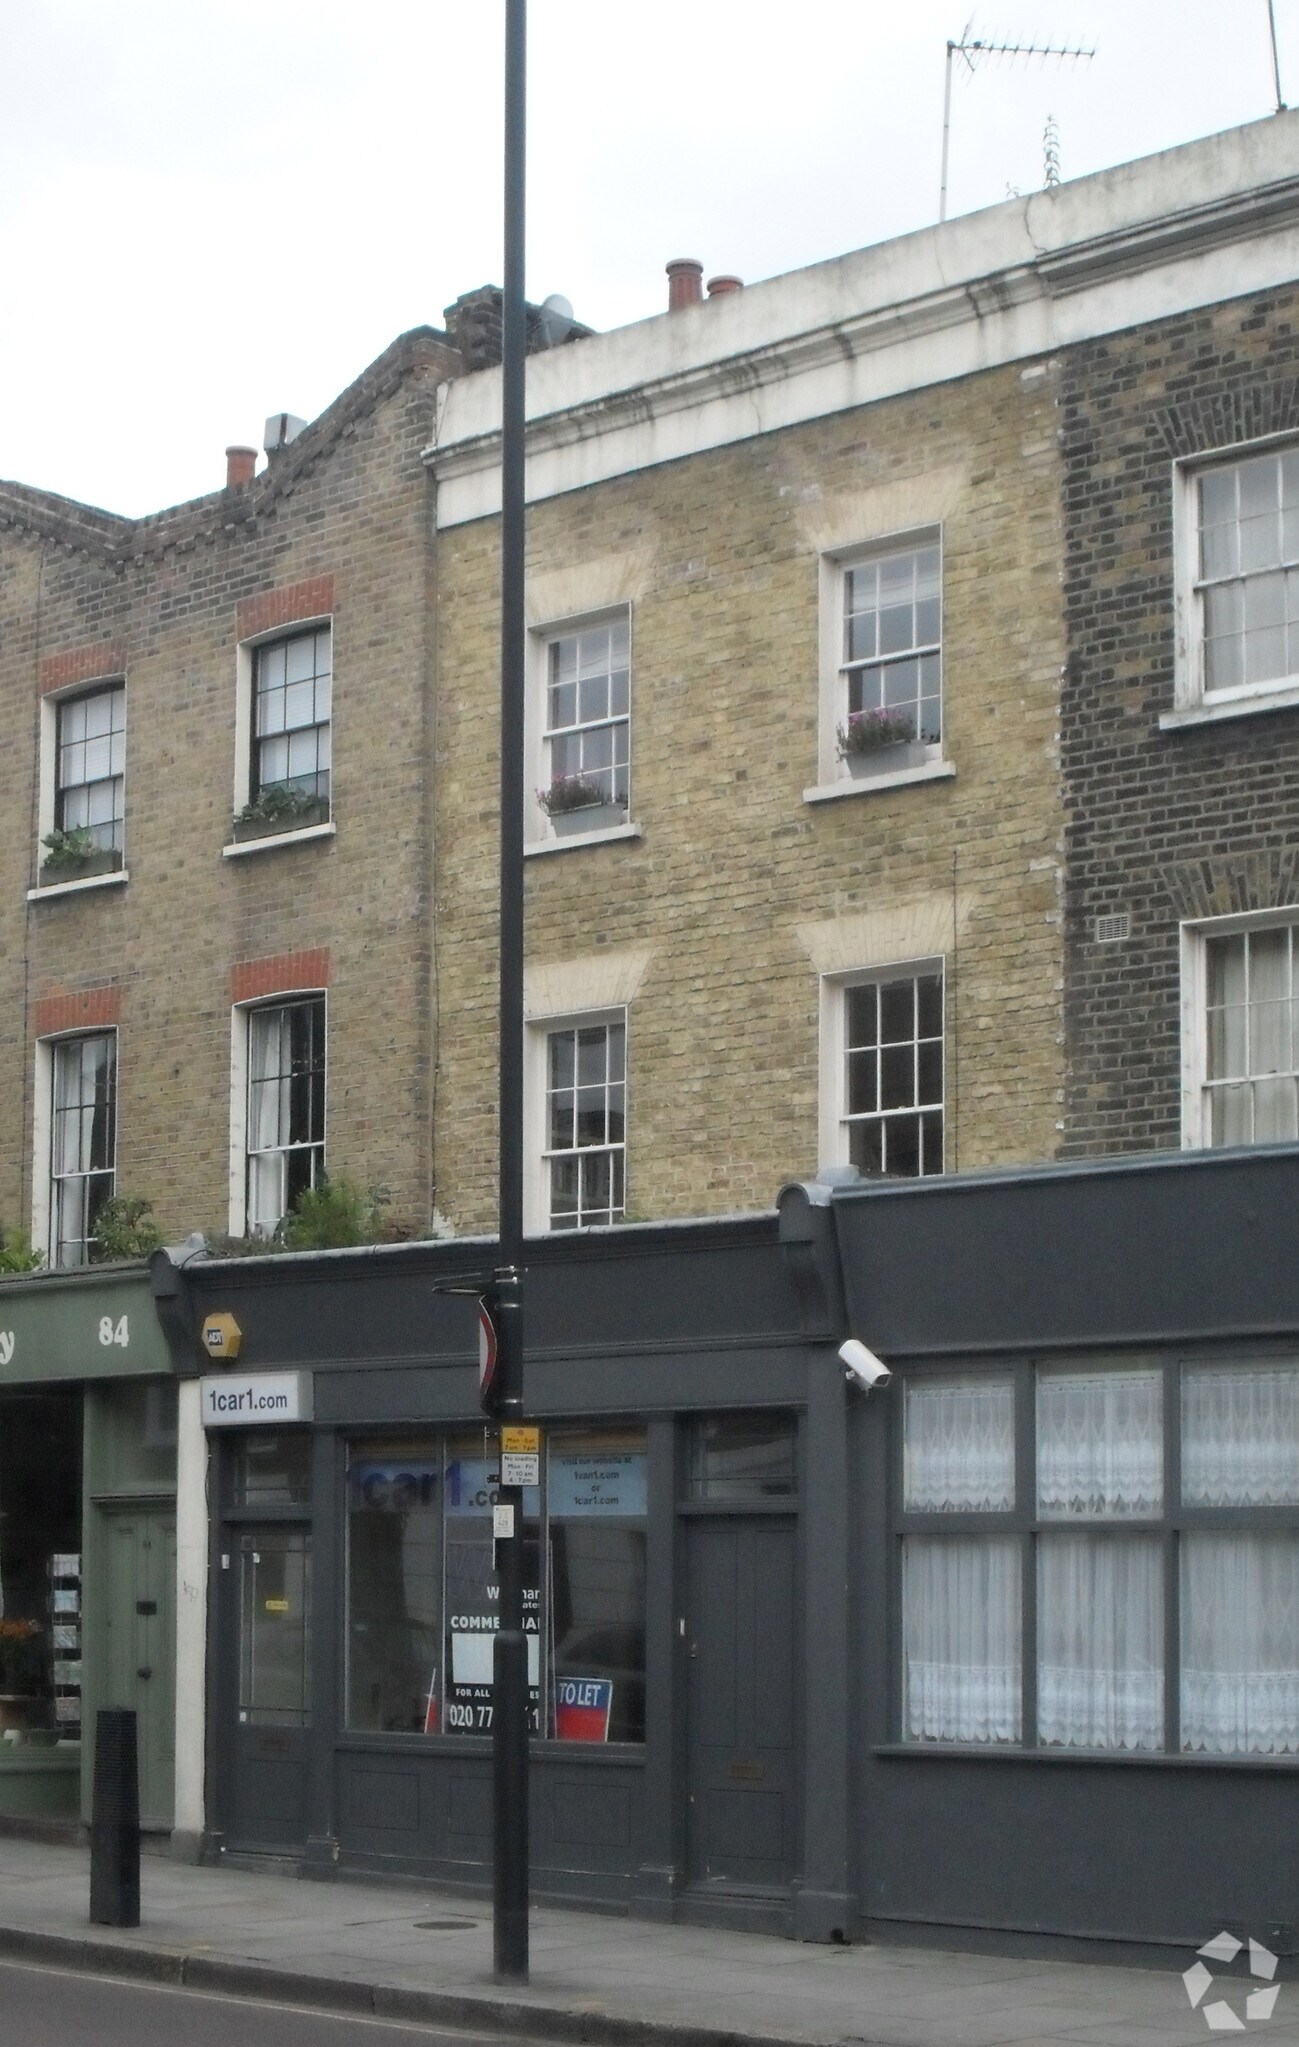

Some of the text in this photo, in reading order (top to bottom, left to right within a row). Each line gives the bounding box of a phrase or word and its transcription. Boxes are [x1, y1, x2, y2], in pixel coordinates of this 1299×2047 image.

[99, 1314, 129, 1347] 84
[210, 1388, 288, 1411] 1car1.com
[455, 1688, 490, 1698] FOR ALL
[559, 1682, 602, 1706] TO LET
[450, 1704, 473, 1727] 020
